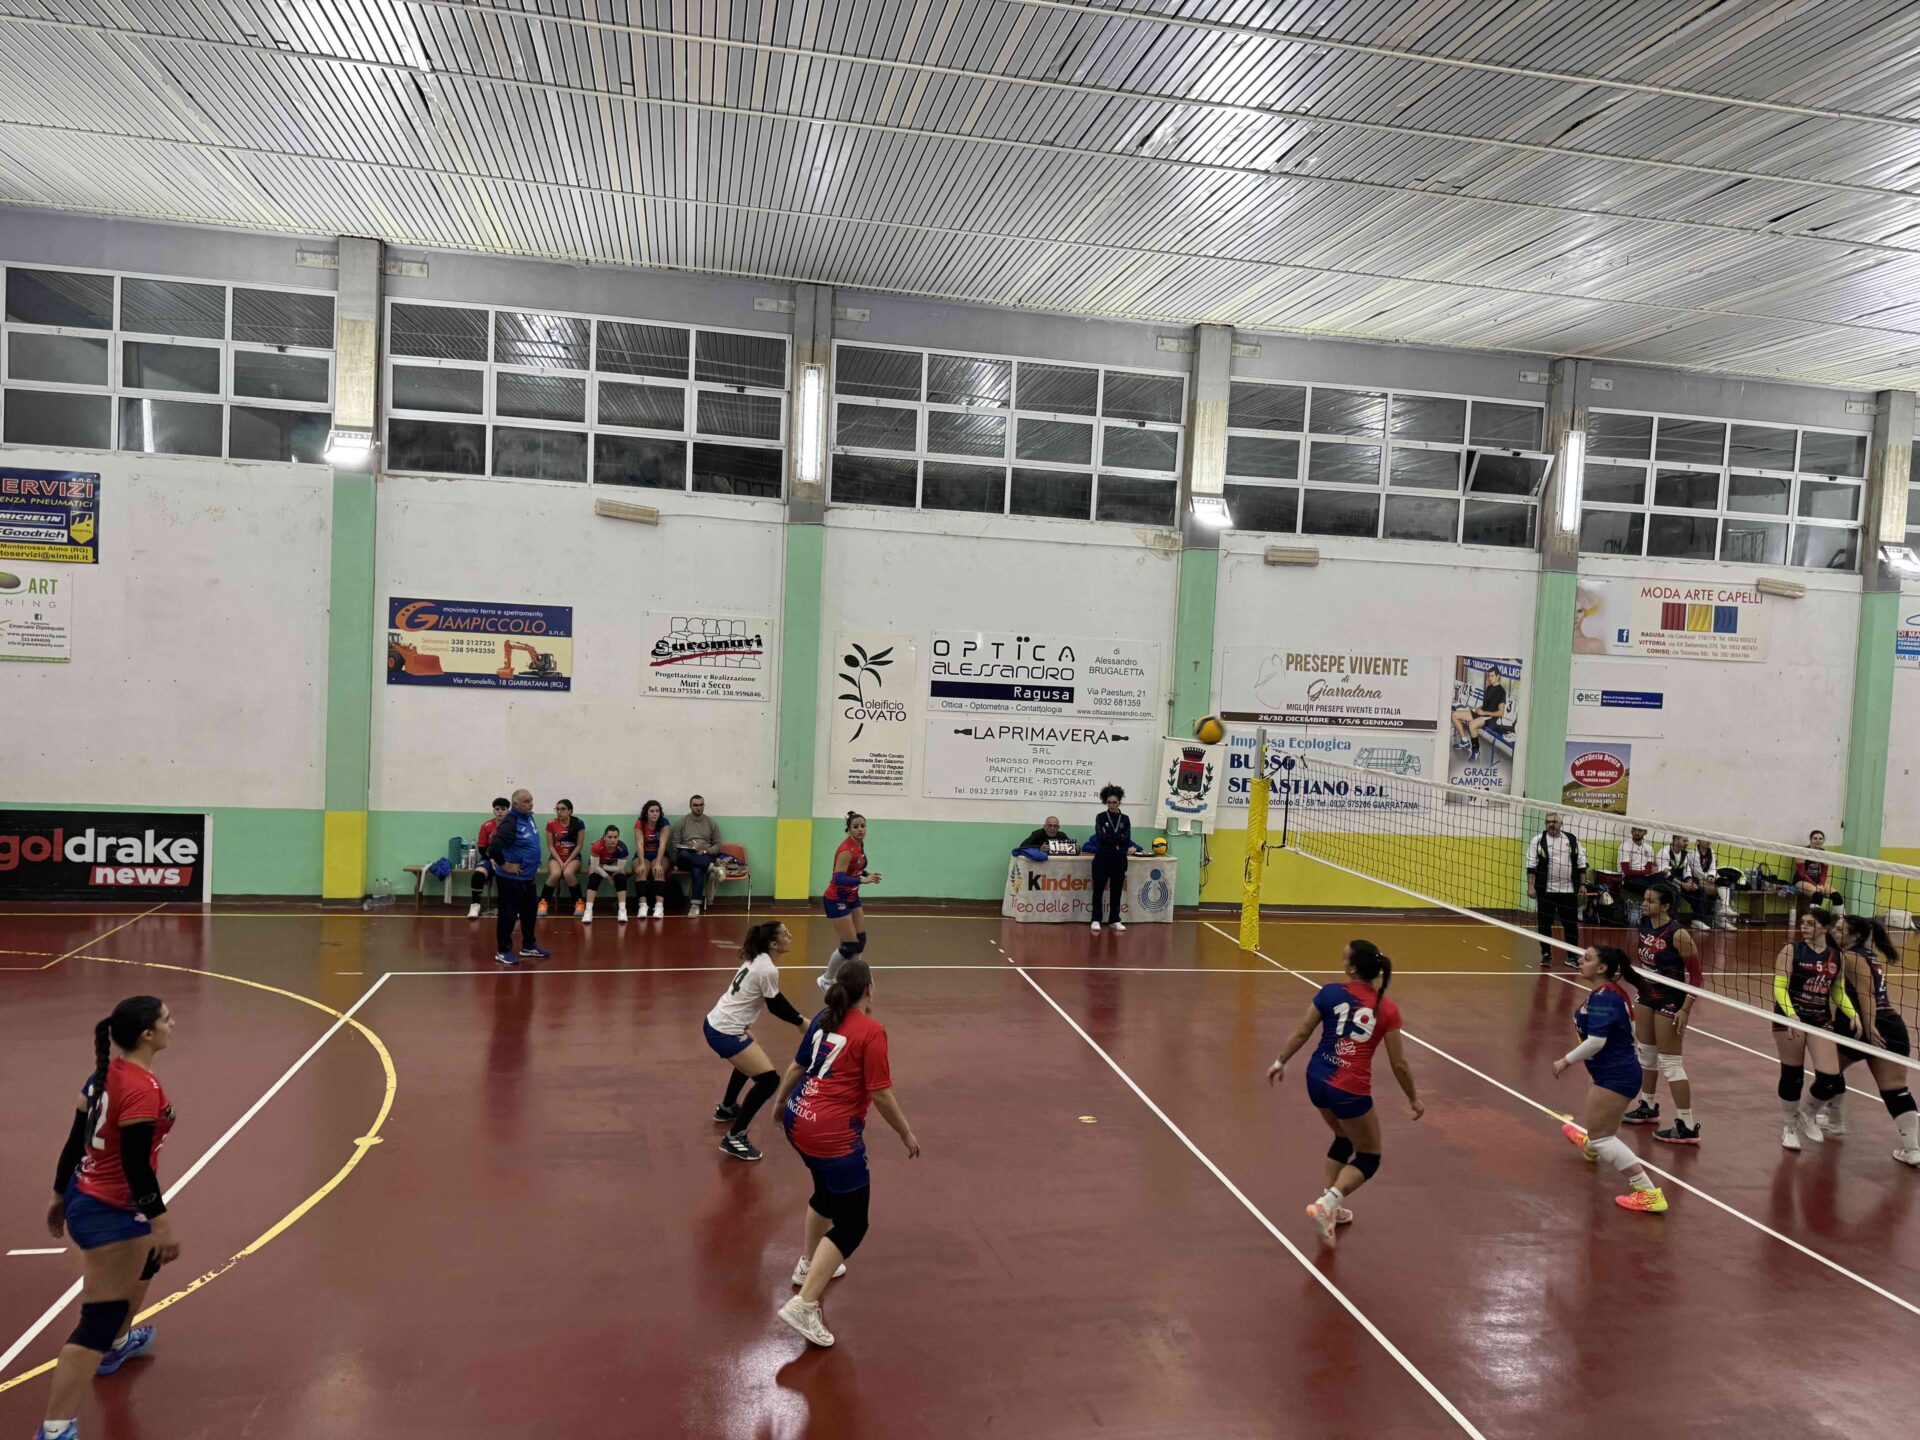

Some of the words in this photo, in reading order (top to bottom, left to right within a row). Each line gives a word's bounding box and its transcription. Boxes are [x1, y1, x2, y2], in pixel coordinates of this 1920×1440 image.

[2, 478, 94, 498] ERVIZI
[30, 498, 93, 508] PNEUMATICI
[0, 513, 61, 523] MICHELIN
[0, 543, 46, 551] Monterosso
[28, 577, 58, 595] ART
[1640, 587, 1681, 600] MODA
[1684, 588, 1714, 601] ARTE
[1717, 590, 1763, 605] CAPELLI
[443, 606, 479, 614] movimento
[395, 601, 547, 634] GIAMPICCOLO
[1095, 656, 1138, 666] Alessandro
[1285, 653, 1346, 674] PRESEPE
[1350, 655, 1409, 676] VIVENTE
[655, 671, 704, 680] Progettazione
[709, 674, 756, 682] Realizzazione
[1088, 666, 1145, 676] BRUGALETTA
[507, 680, 551, 688] GIARRATANA
[680, 680, 699, 688] Muri
[708, 681, 731, 689] Secco
[1341, 675, 1350, 683] di
[1013, 686, 1071, 702] Ragusa
[1087, 688, 1099, 696] Via
[1101, 688, 1135, 698] Paestum,
[1137, 690, 1146, 698] 21
[1306, 678, 1383, 701] Giarratana
[865, 699, 904, 711] oleificio
[941, 700, 963, 709] Ottica
[969, 701, 1009, 711] Optometria
[1093, 698, 1112, 706] 0932
[1114, 698, 1141, 707] 681359
[844, 706, 907, 722] COVATO
[1286, 703, 1314, 712] MIGLIOR
[1315, 705, 1344, 714] PRESEPE
[1346, 706, 1373, 714] VIVENTE
[1285, 715, 1329, 724] DICEMBRE
[1362, 719, 1404, 727] GENNAIO
[973, 726, 995, 740] LA
[998, 726, 1109, 744] PRIMAVERA
[1230, 735, 1285, 749] Impsa
[1288, 737, 1352, 752] Ecologica
[1032, 747, 1051, 755] SRL
[989, 766, 1026, 774] PANIFICI
[1035, 768, 1092, 776] PASTICCERIE
[1463, 768, 1499, 777] GRAZIE
[984, 775, 1034, 784] GELATERIE
[1043, 777, 1095, 786] RISTORANTI
[1450, 776, 1504, 787] CAMPIONE
[1228, 777, 1350, 797] SEASTIANO
[1038, 790, 1057, 798] 0932
[1372, 801, 1418, 810] GIARRATANA
[0, 828, 199, 871] goldrake
[94, 867, 182, 885] news
[1036, 898, 1070, 913] delle
[1072, 898, 1129, 913] Proine
[1816, 960, 1823, 972] 5
[732, 967, 750, 996] 4
[1333, 1002, 1377, 1043] 19
[805, 1028, 848, 1079] 17
[787, 1098, 817, 1122] NGELICA
